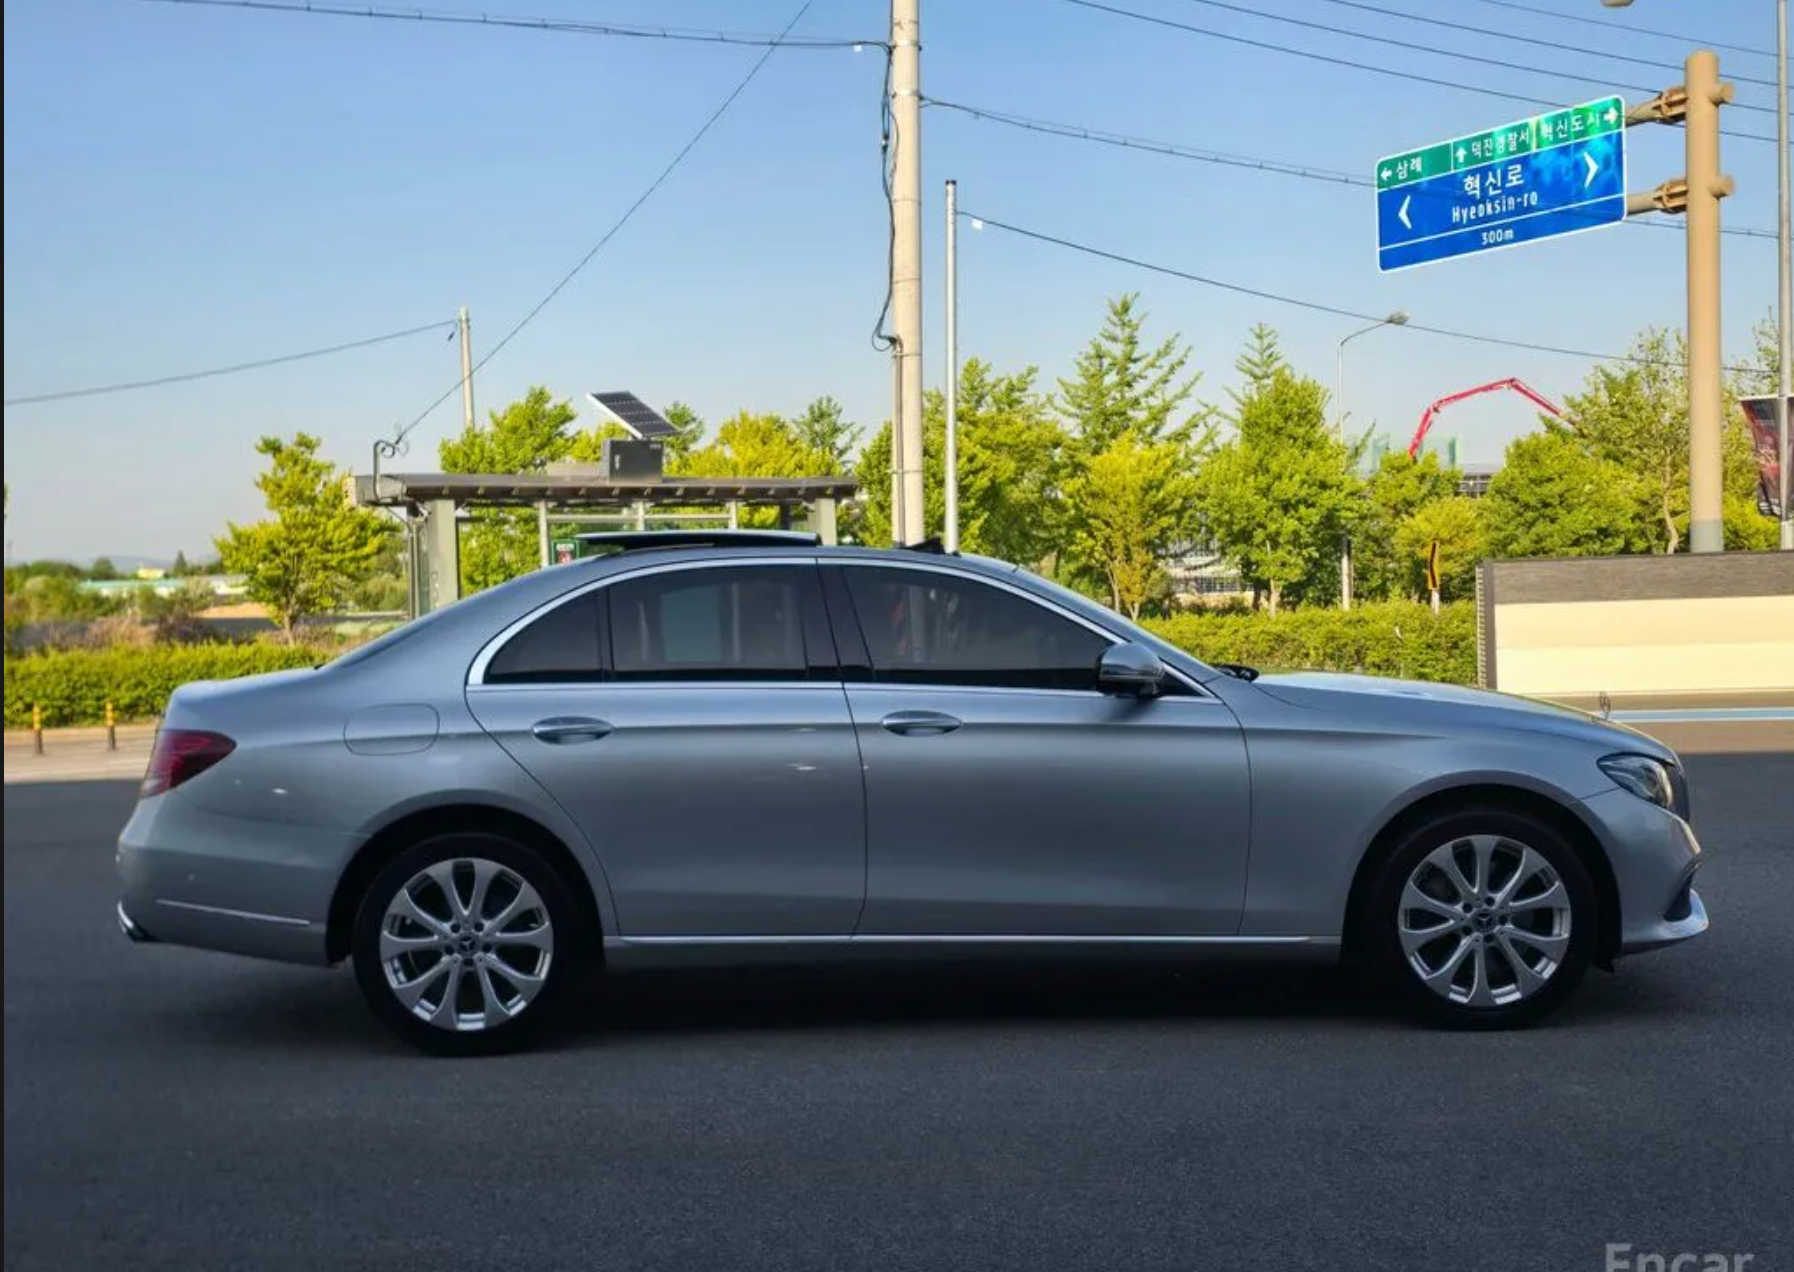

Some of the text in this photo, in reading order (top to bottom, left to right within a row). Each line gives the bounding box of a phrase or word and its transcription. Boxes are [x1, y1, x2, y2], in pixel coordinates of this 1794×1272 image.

[1396, 157, 1423, 180] 삼례
[1463, 164, 1524, 199] 혁신로
[1452, 191, 1538, 225] Hyeoksin-ro
[1481, 229, 1514, 245] 300m
